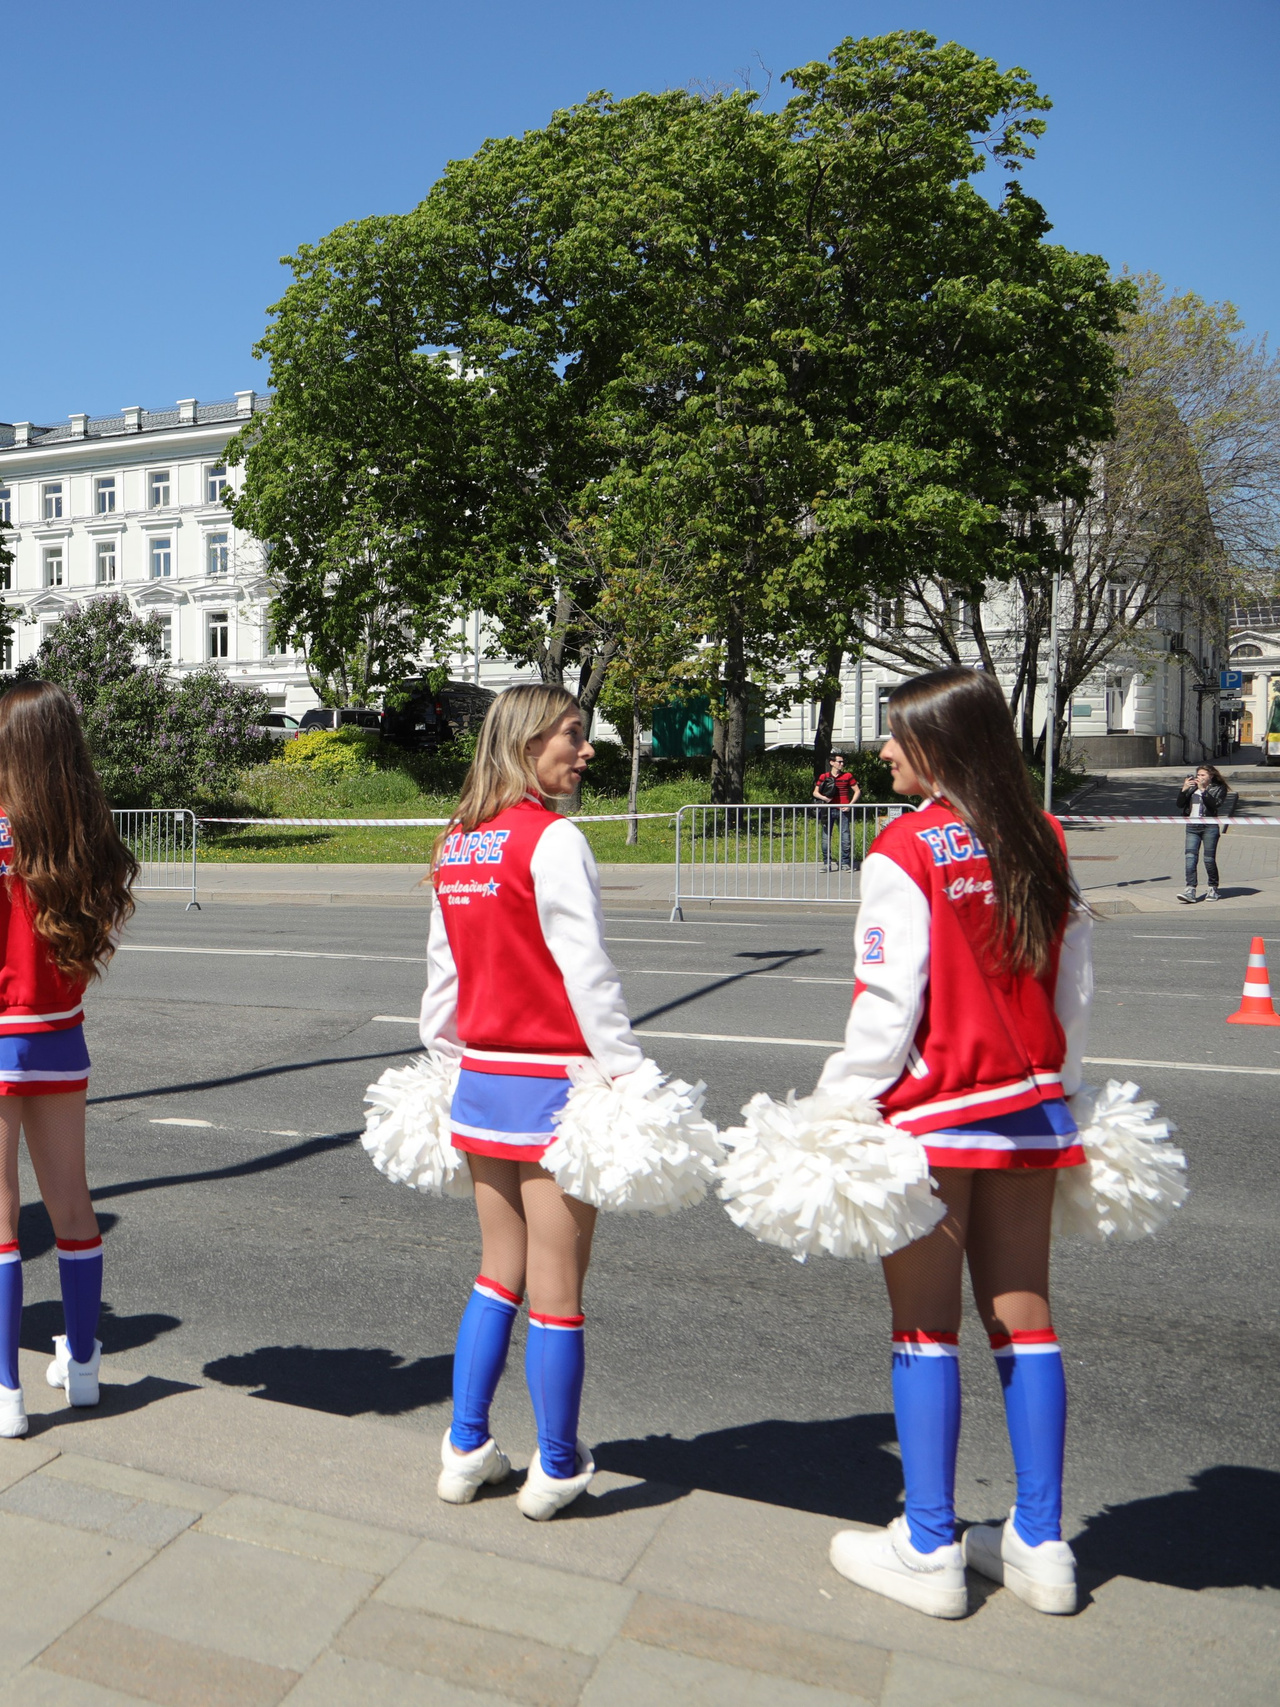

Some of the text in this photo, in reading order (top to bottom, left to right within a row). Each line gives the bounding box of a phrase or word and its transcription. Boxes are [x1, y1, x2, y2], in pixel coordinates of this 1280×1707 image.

[1226, 673, 1238, 687] P
[435, 829, 511, 870] CLIPSE
[437, 879, 489, 898] heerleading
[447, 893, 471, 906] team
[862, 927, 885, 964] 2
